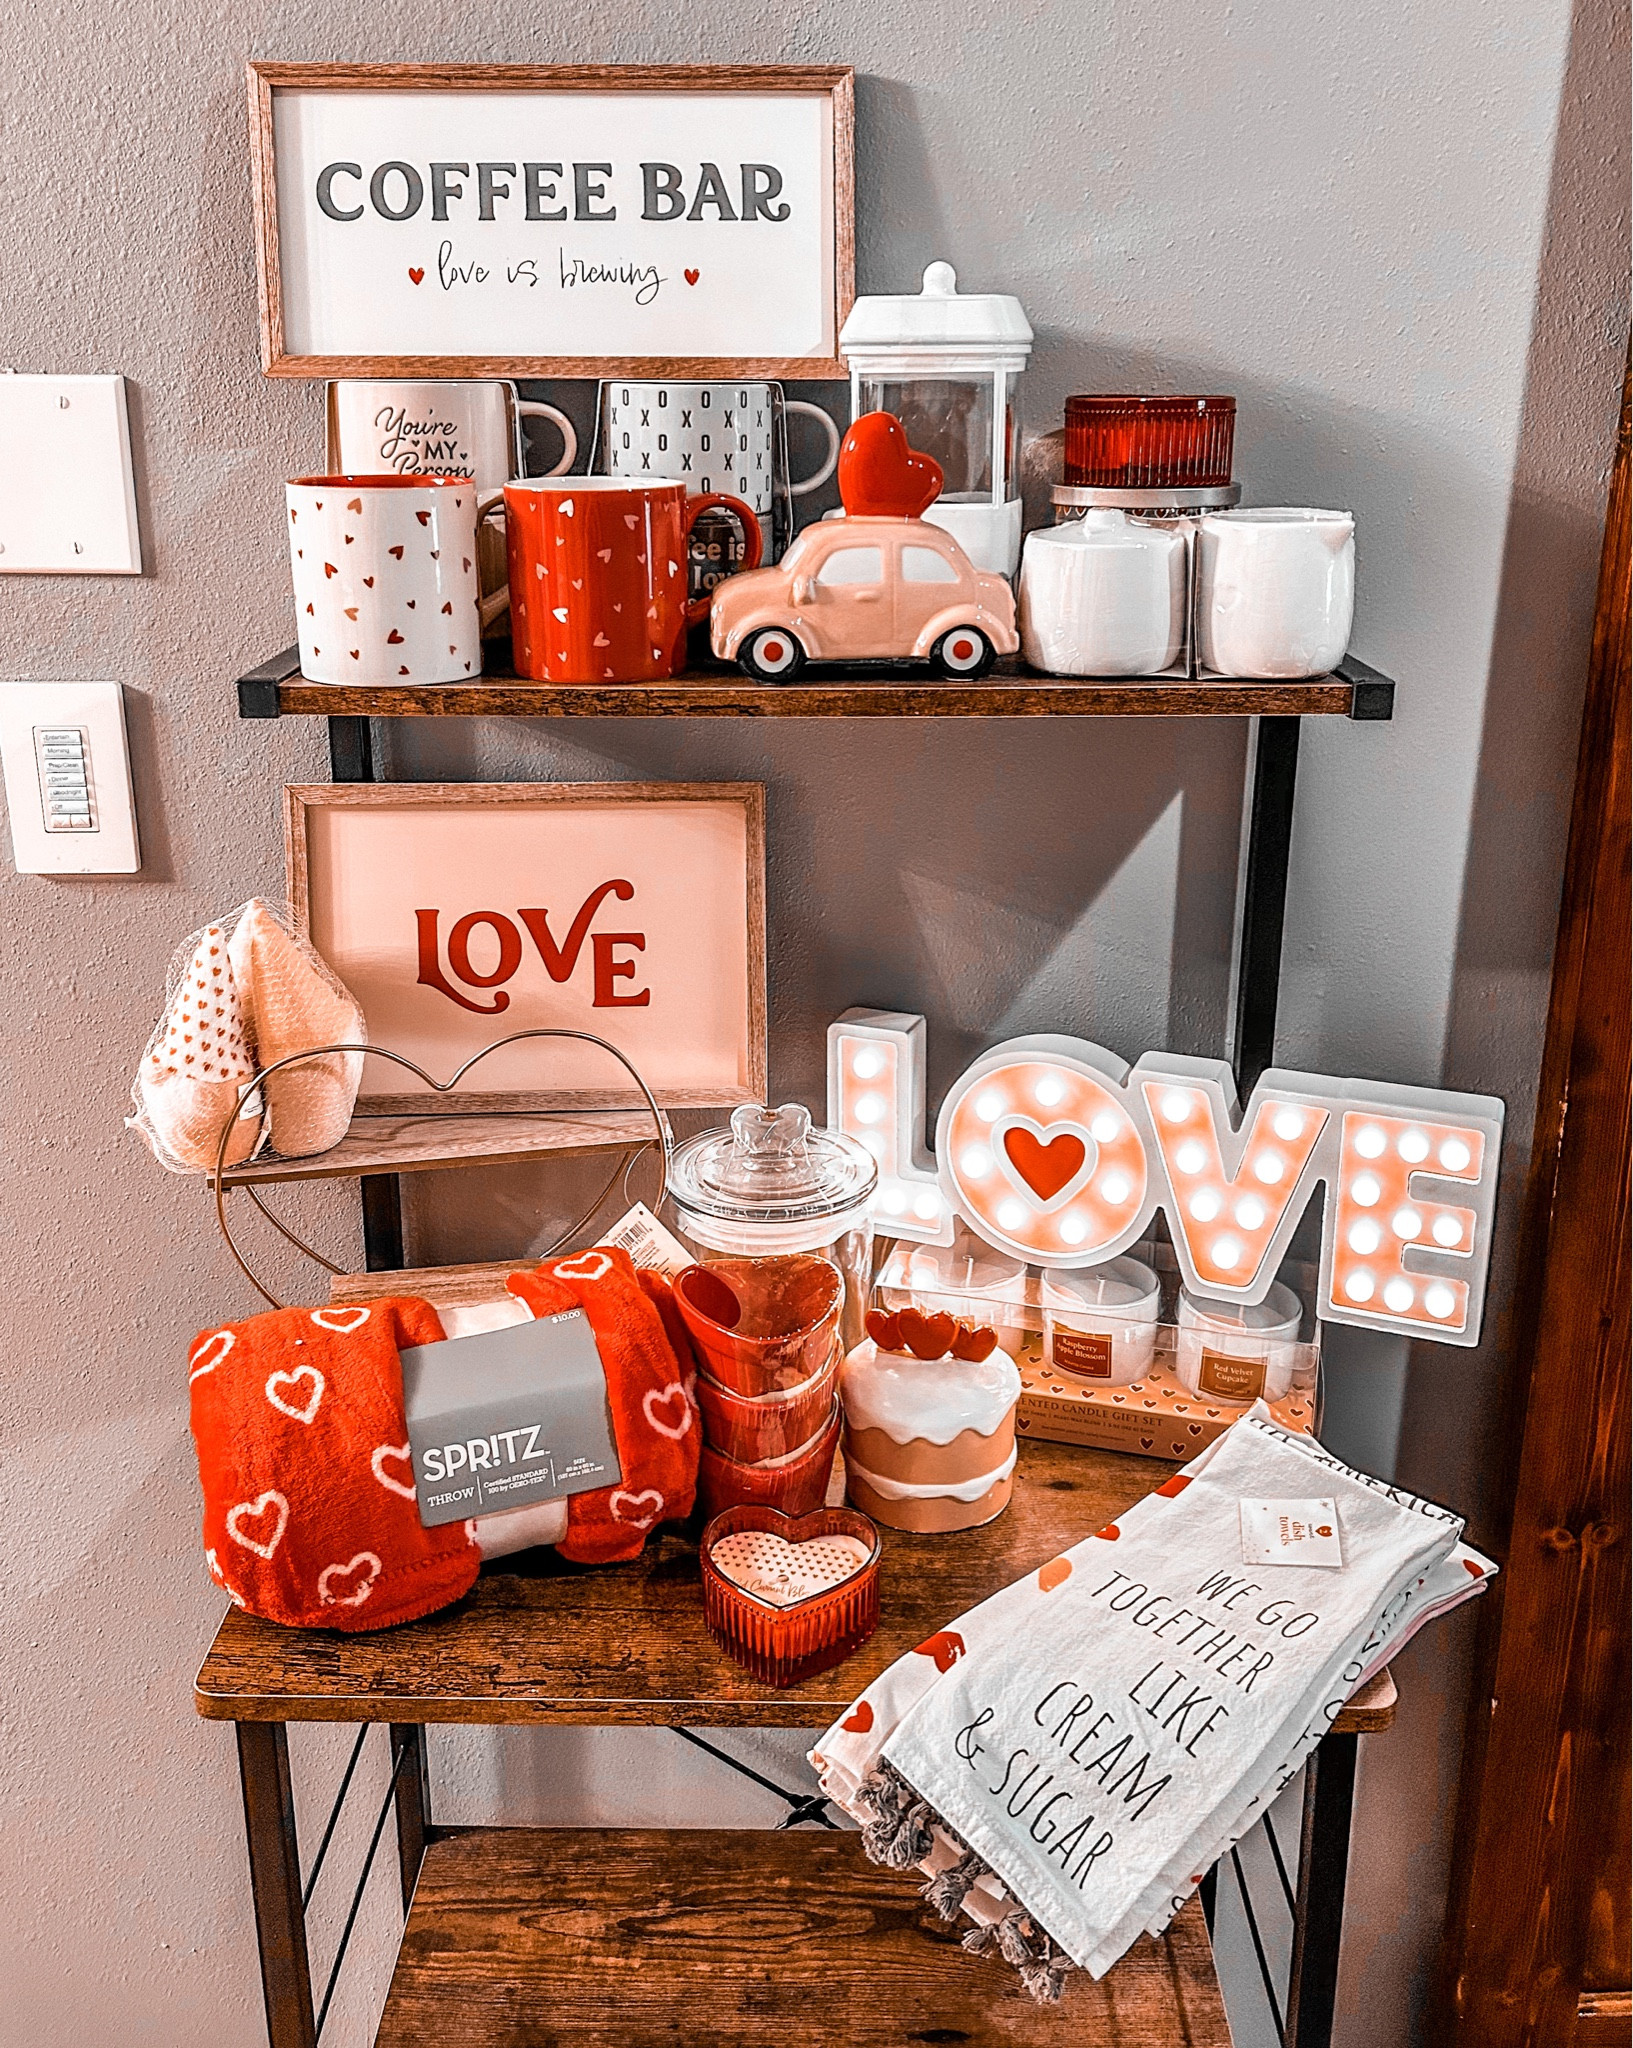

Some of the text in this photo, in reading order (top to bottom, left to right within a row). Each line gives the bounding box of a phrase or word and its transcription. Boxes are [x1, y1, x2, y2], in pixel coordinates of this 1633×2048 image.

[316, 161, 791, 222] COFFEE BAR
[438, 240, 669, 306] love is brewing
[374, 406, 458, 459] You're
[392, 451, 475, 479] Person
[424, 440, 458, 460] MY
[415, 878, 650, 1015] LOVE
[828, 1010, 1505, 1347] LOVE
[552, 1310, 581, 1324] $10.00
[1056, 1342, 1107, 1361] Apple Blossom
[1062, 1337, 1098, 1354] Raspberry
[1213, 1362, 1254, 1376] Red Velvet
[1216, 1372, 1250, 1384] Cupcake
[1018, 1397, 1060, 1411] ENTED
[1062, 1404, 1109, 1419] CANDLE
[1112, 1411, 1140, 1423] GIFT
[1142, 1415, 1164, 1427] SET
[483, 1468, 549, 1488] Certified STANDARD
[488, 1485, 500, 1495] 100
[500, 1484, 509, 1493] by
[427, 1486, 475, 1508] THROW
[1279, 1516, 1294, 1546] towels
[1292, 1521, 1306, 1541] dish
[1196, 1569, 1320, 1639] WE GO
[1091, 1570, 1275, 1694] TOGETHER
[1128, 1661, 1230, 1759] LIKE
[1034, 1681, 1174, 1822] CREAM
[955, 1707, 1114, 1890] & SUGAR
